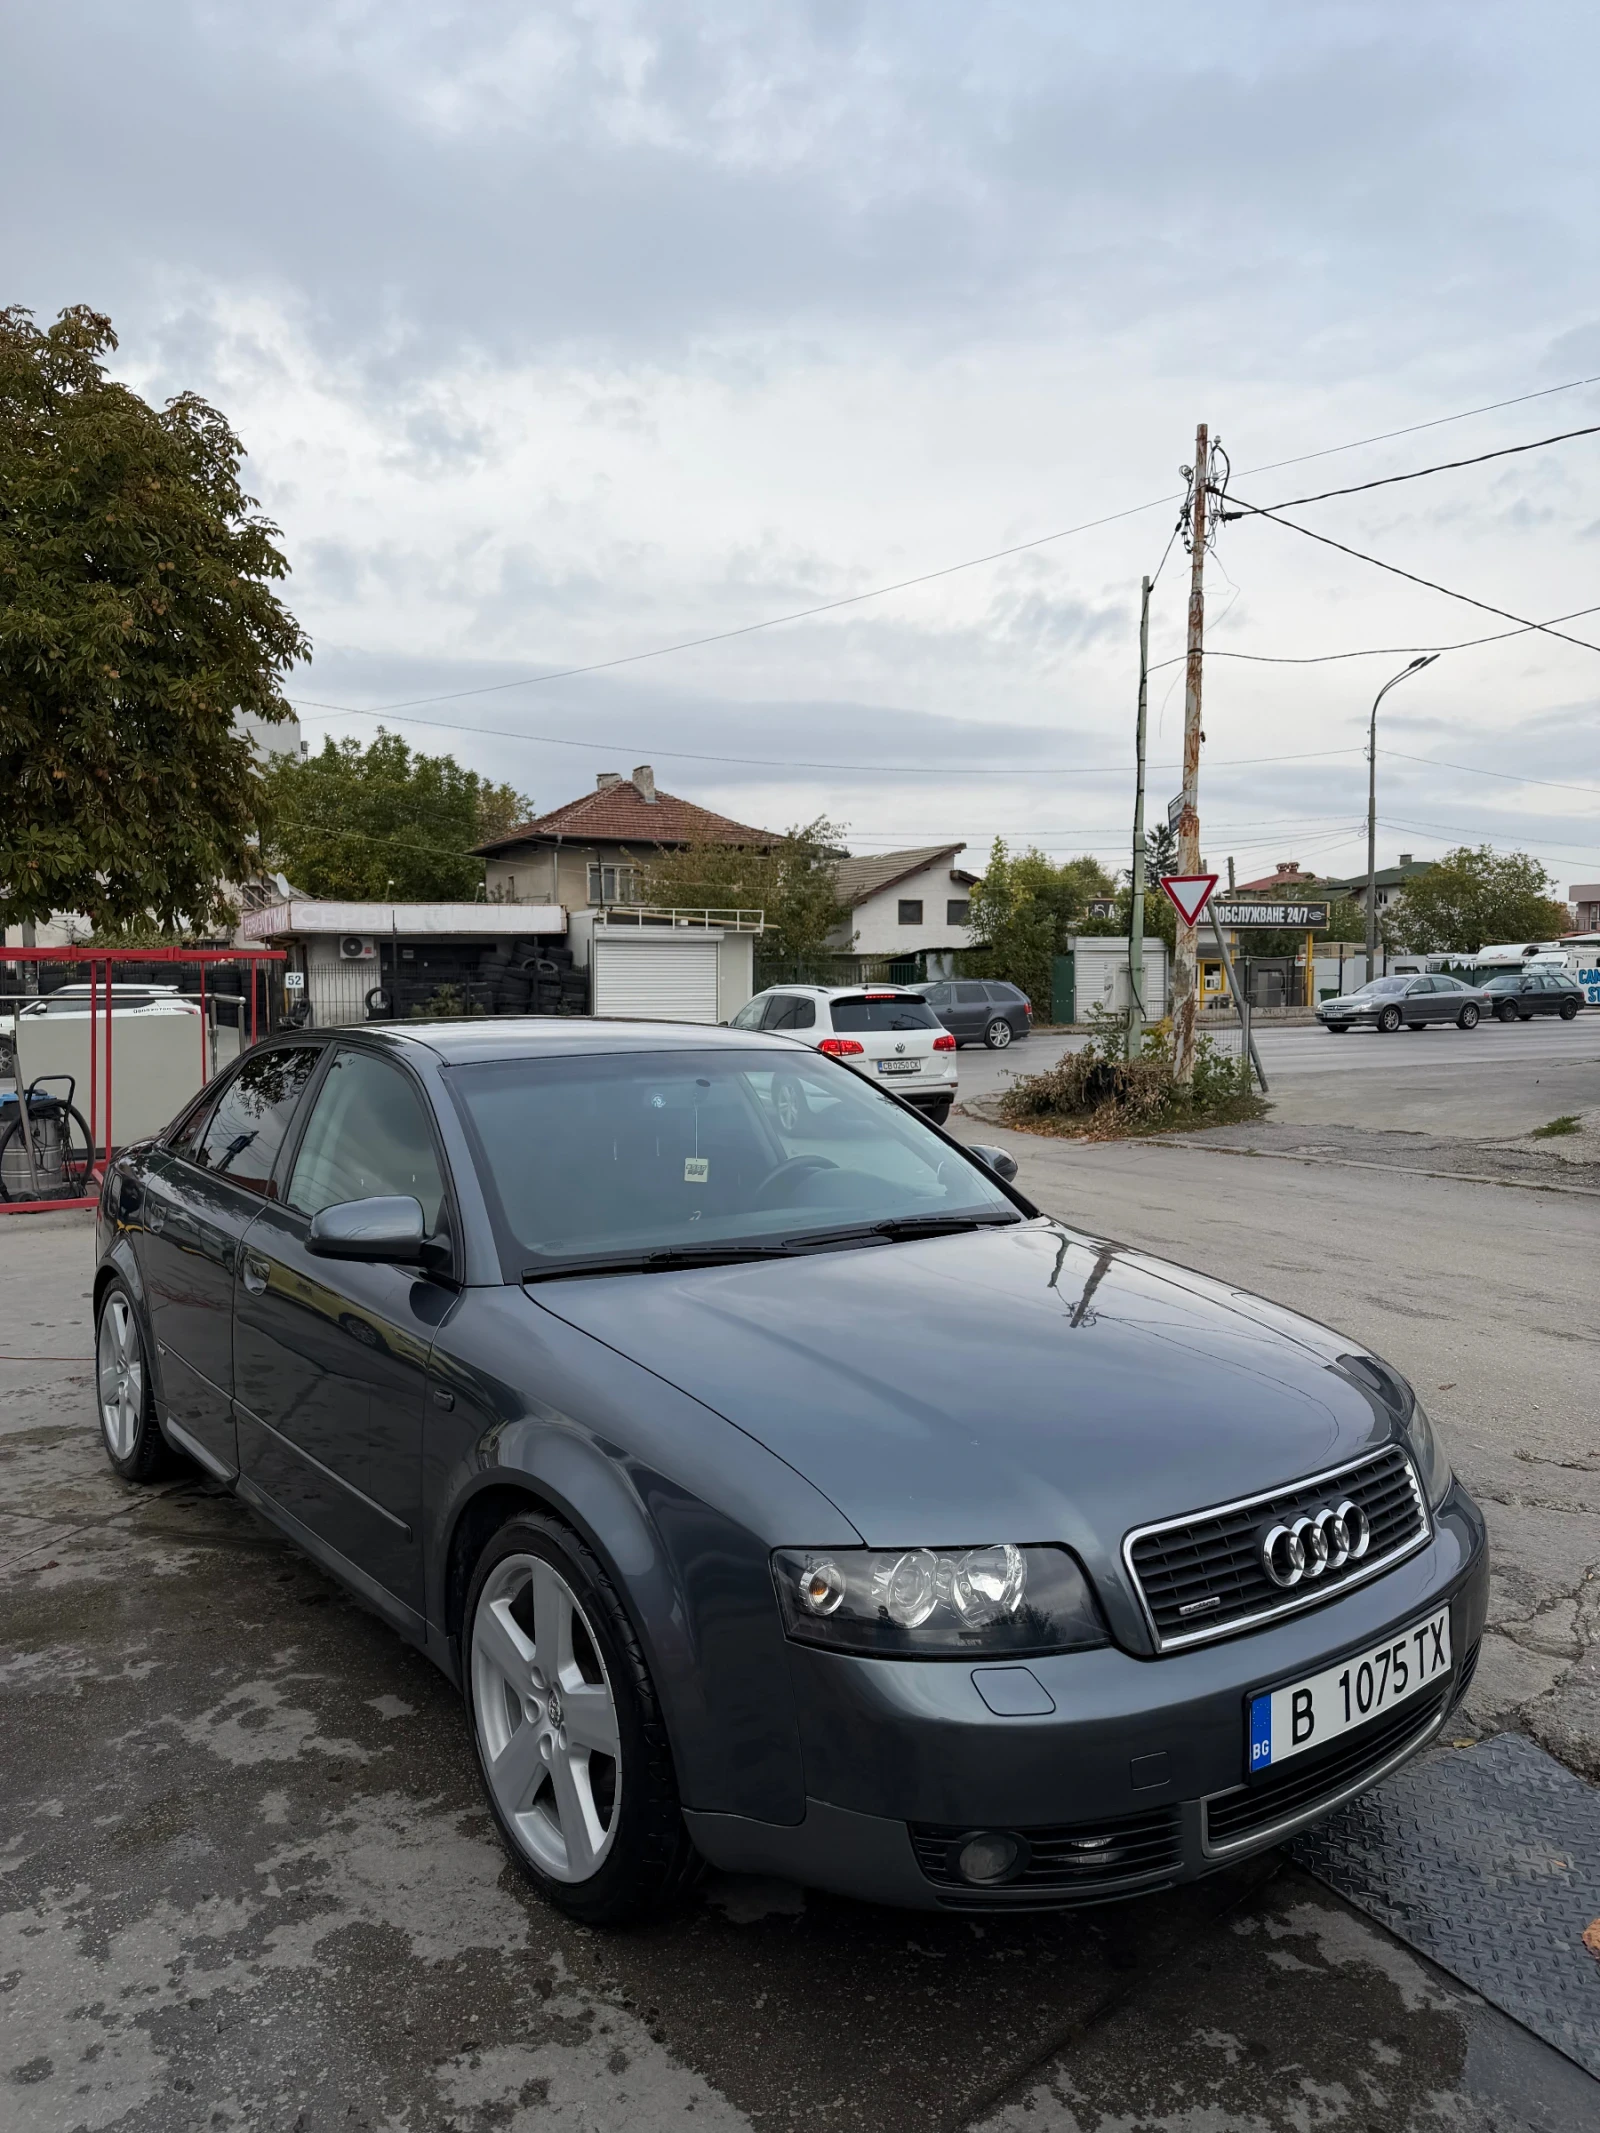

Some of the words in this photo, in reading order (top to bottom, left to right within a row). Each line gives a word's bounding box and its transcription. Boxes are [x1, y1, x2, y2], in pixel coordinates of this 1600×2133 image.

[1286, 907, 1308, 923] 24/7
[288, 975, 301, 985] 52
[1291, 1688, 1315, 1746] B
[1339, 1640, 1408, 1723] 1075
[1413, 1616, 1446, 1680] TX
[1252, 1740, 1269, 1761] BG
